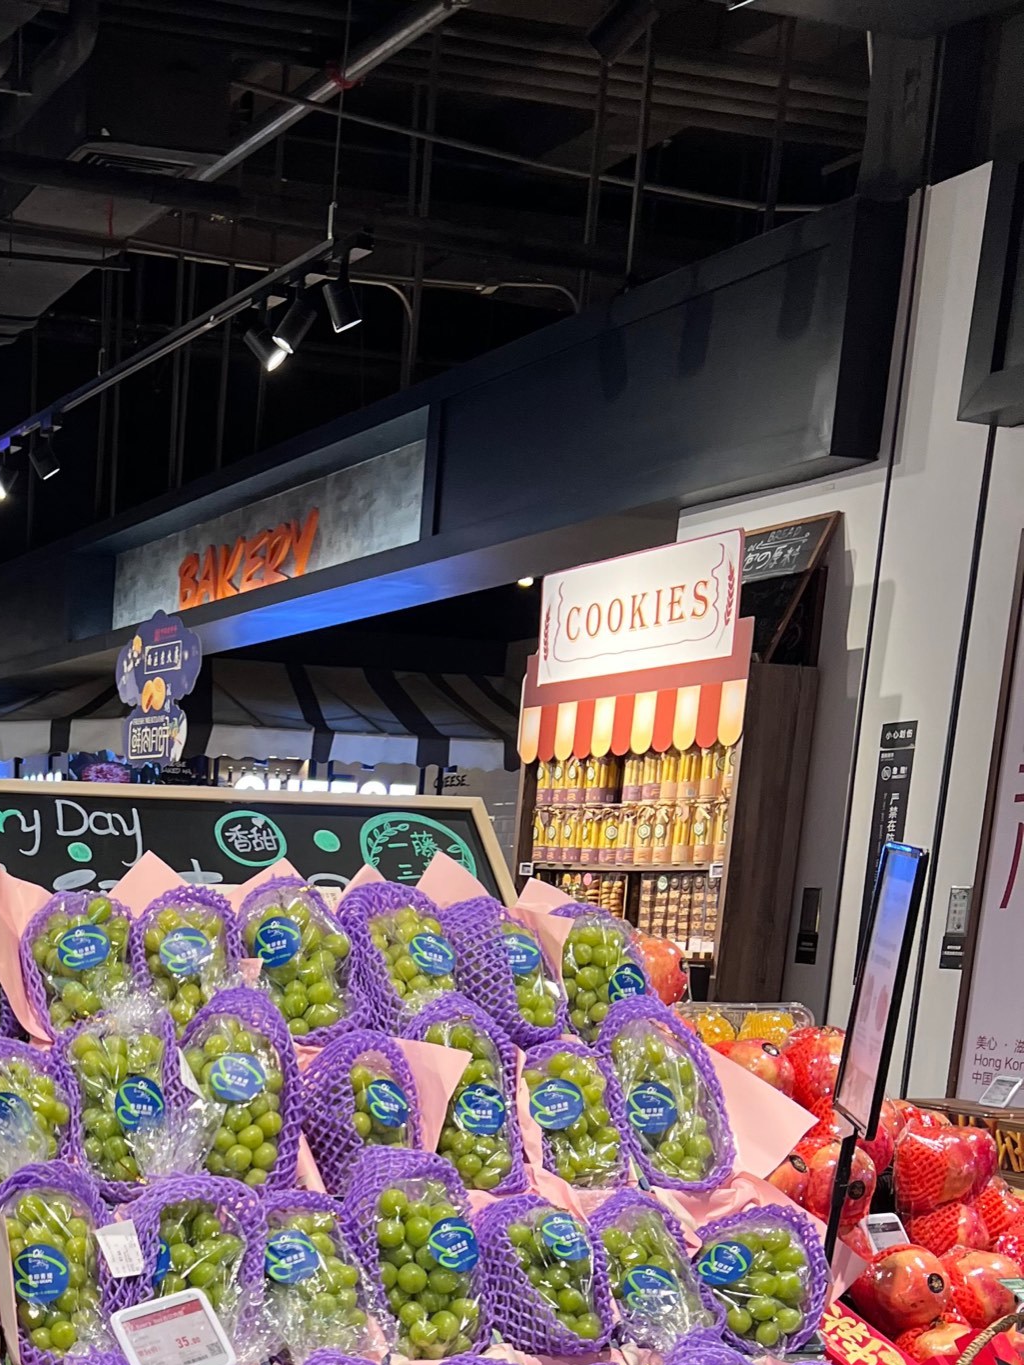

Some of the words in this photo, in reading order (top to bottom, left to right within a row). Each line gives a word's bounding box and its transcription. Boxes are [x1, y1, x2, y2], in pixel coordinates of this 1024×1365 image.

[179, 506, 319, 611] BAKERY
[565, 579, 711, 642] COOKIES
[433, 775, 468, 788] CEESE
[55, 799, 143, 867] Day
[224, 824, 278, 853] 香甜
[974, 1053, 1002, 1071] Hong
[972, 1070, 994, 1086] 中国
